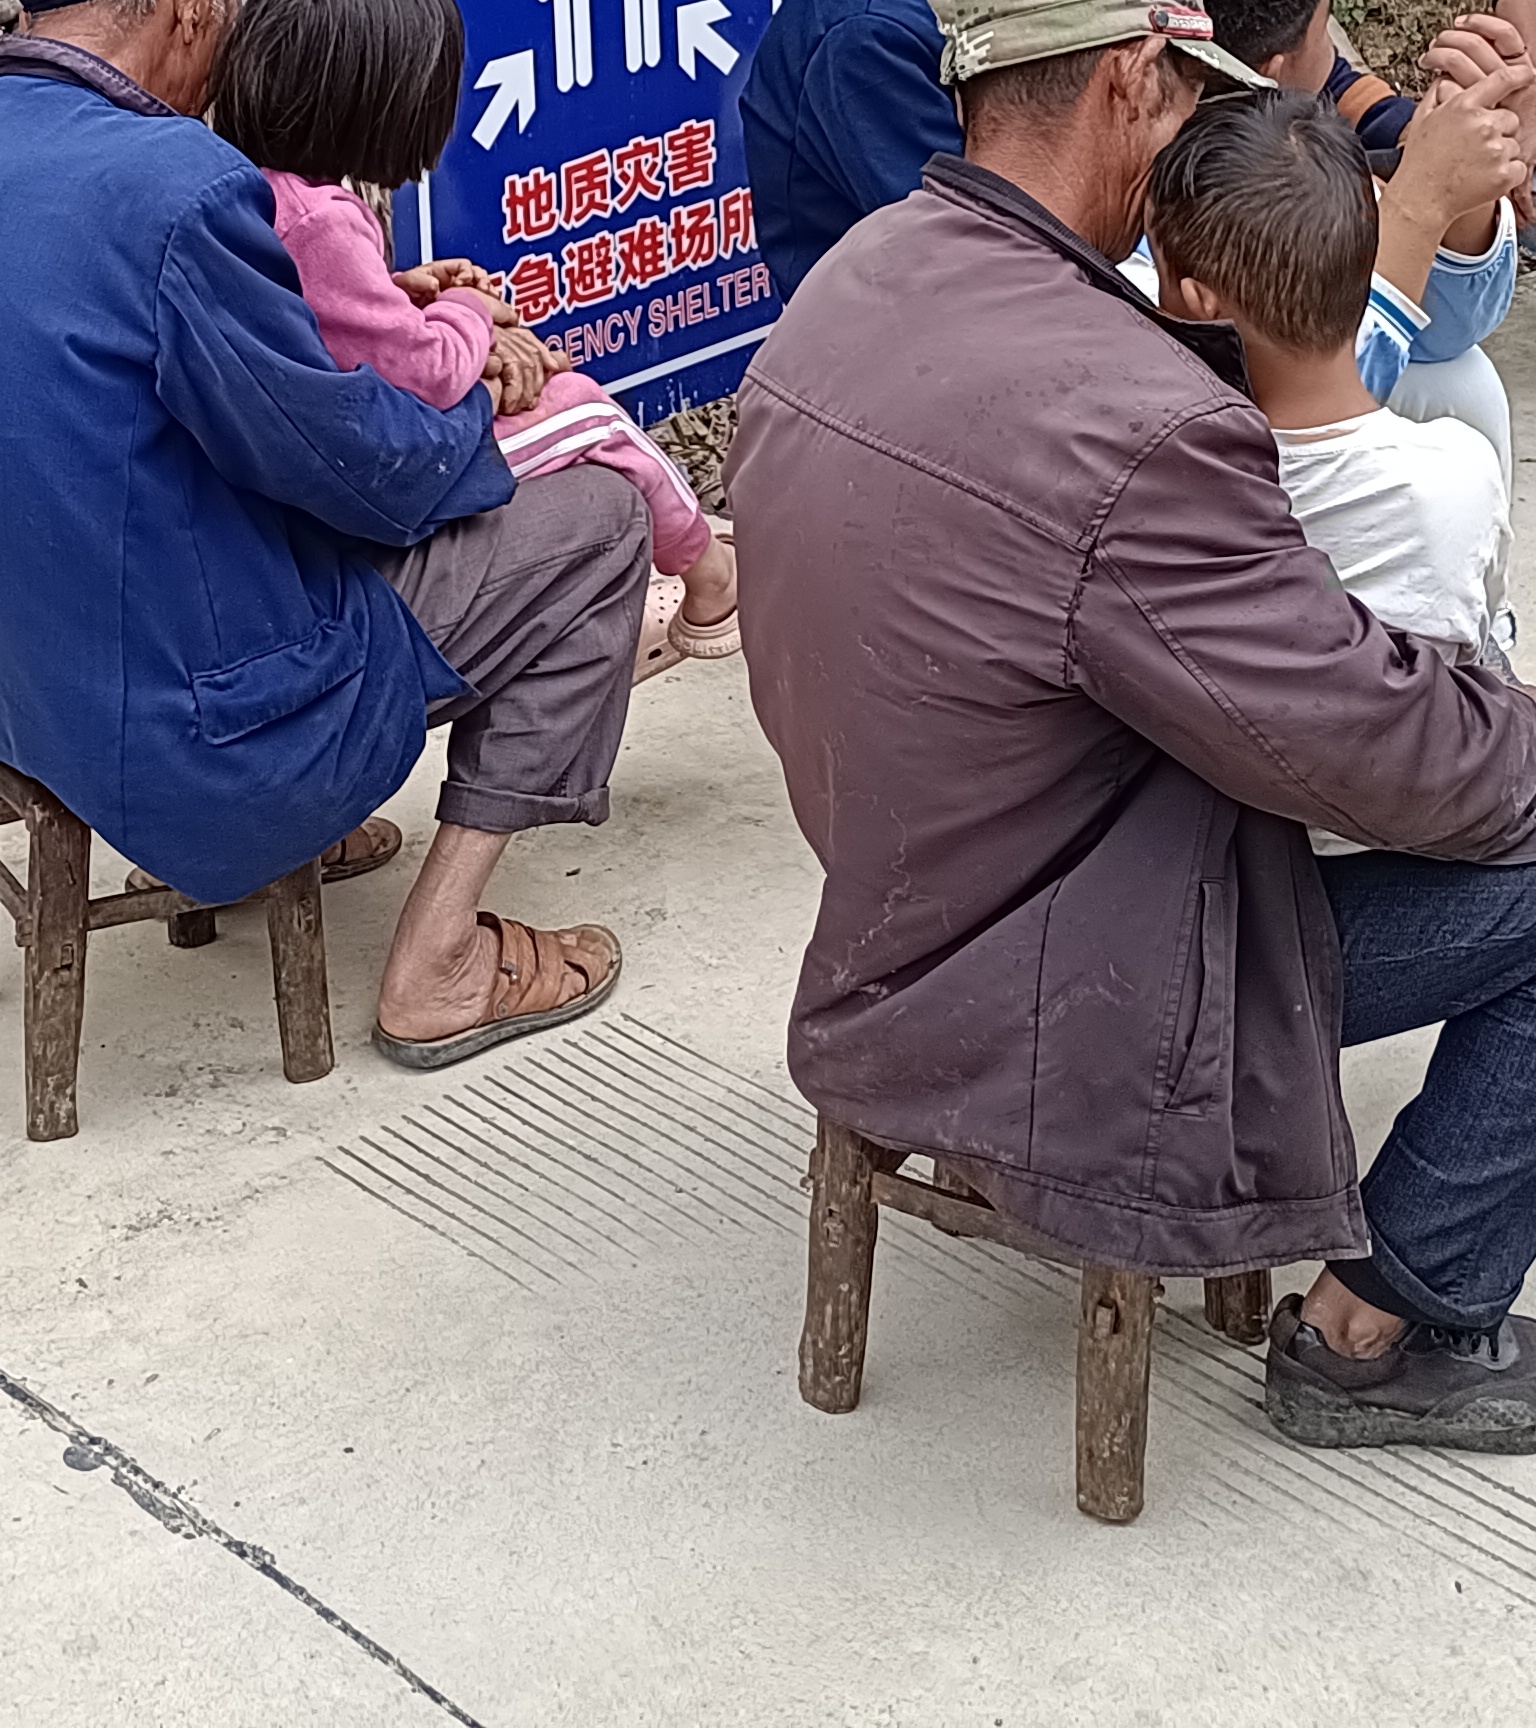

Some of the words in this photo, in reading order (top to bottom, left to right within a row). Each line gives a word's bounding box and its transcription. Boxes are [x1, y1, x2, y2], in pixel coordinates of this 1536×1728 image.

[502, 119, 717, 245] 地质灾害
[488, 186, 758, 328] 急避难场所
[648, 263, 771, 338] SHELTER
